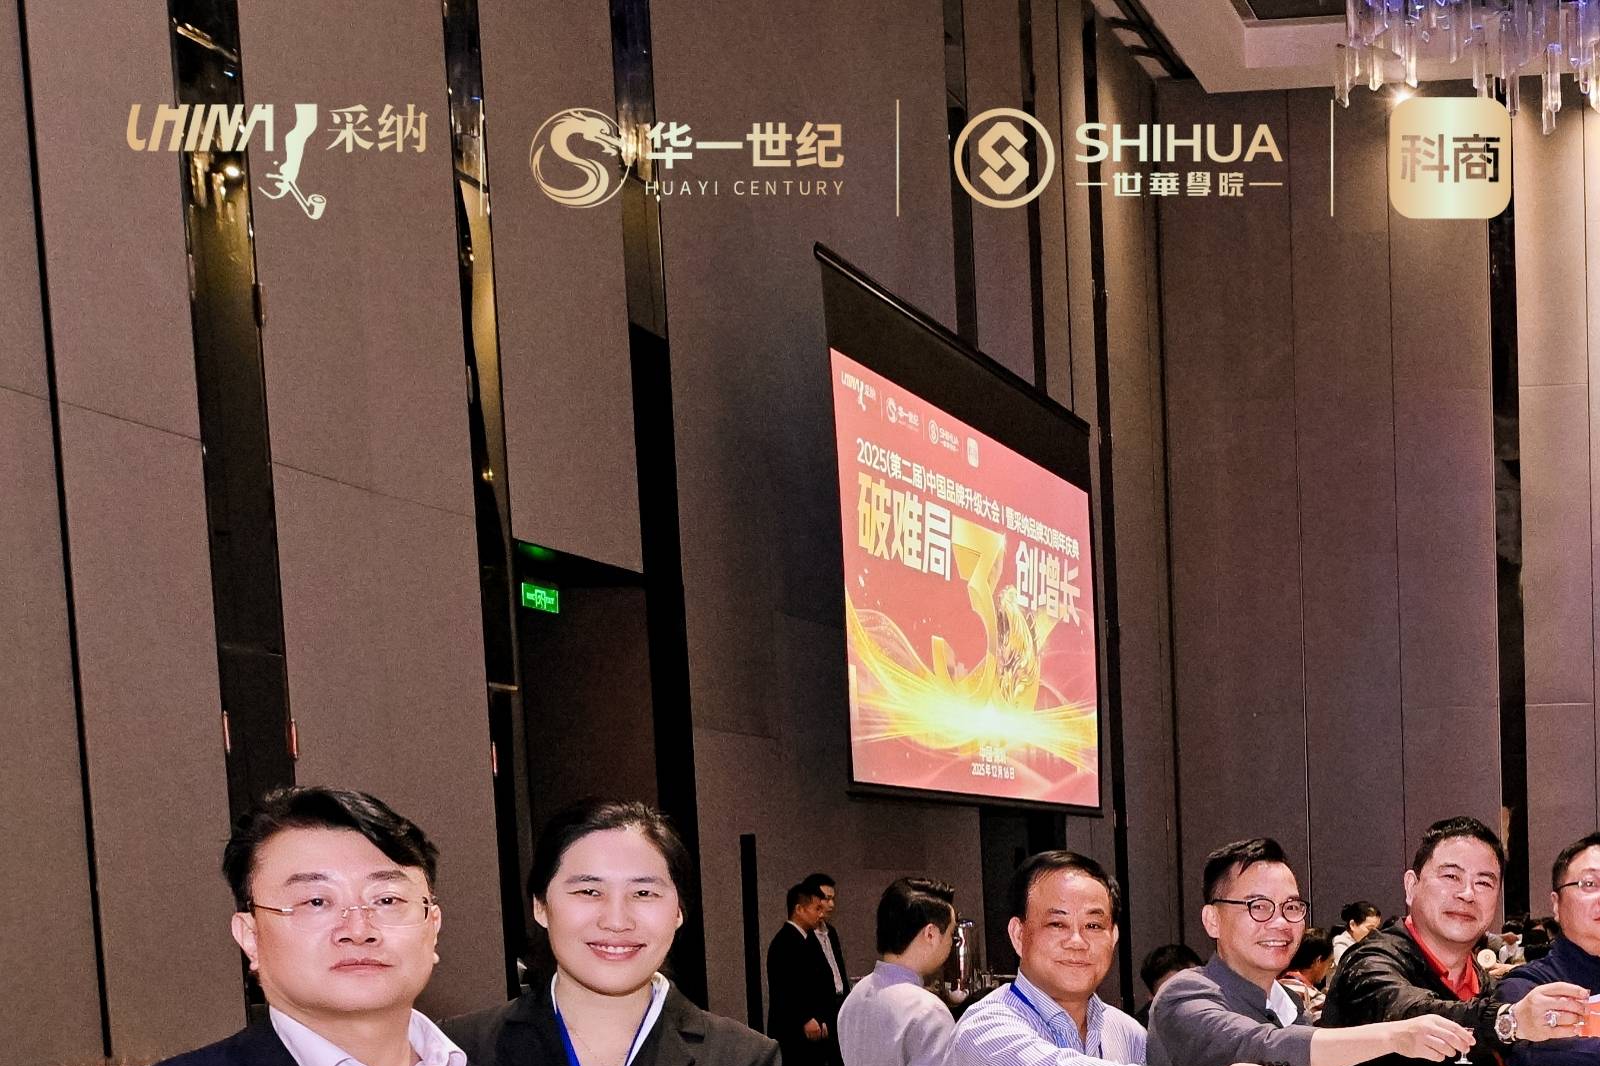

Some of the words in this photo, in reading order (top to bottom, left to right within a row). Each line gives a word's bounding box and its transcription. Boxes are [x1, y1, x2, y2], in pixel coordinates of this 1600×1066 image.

[857, 471, 951, 582] 破难局
[1014, 541, 1081, 627] 创增长
